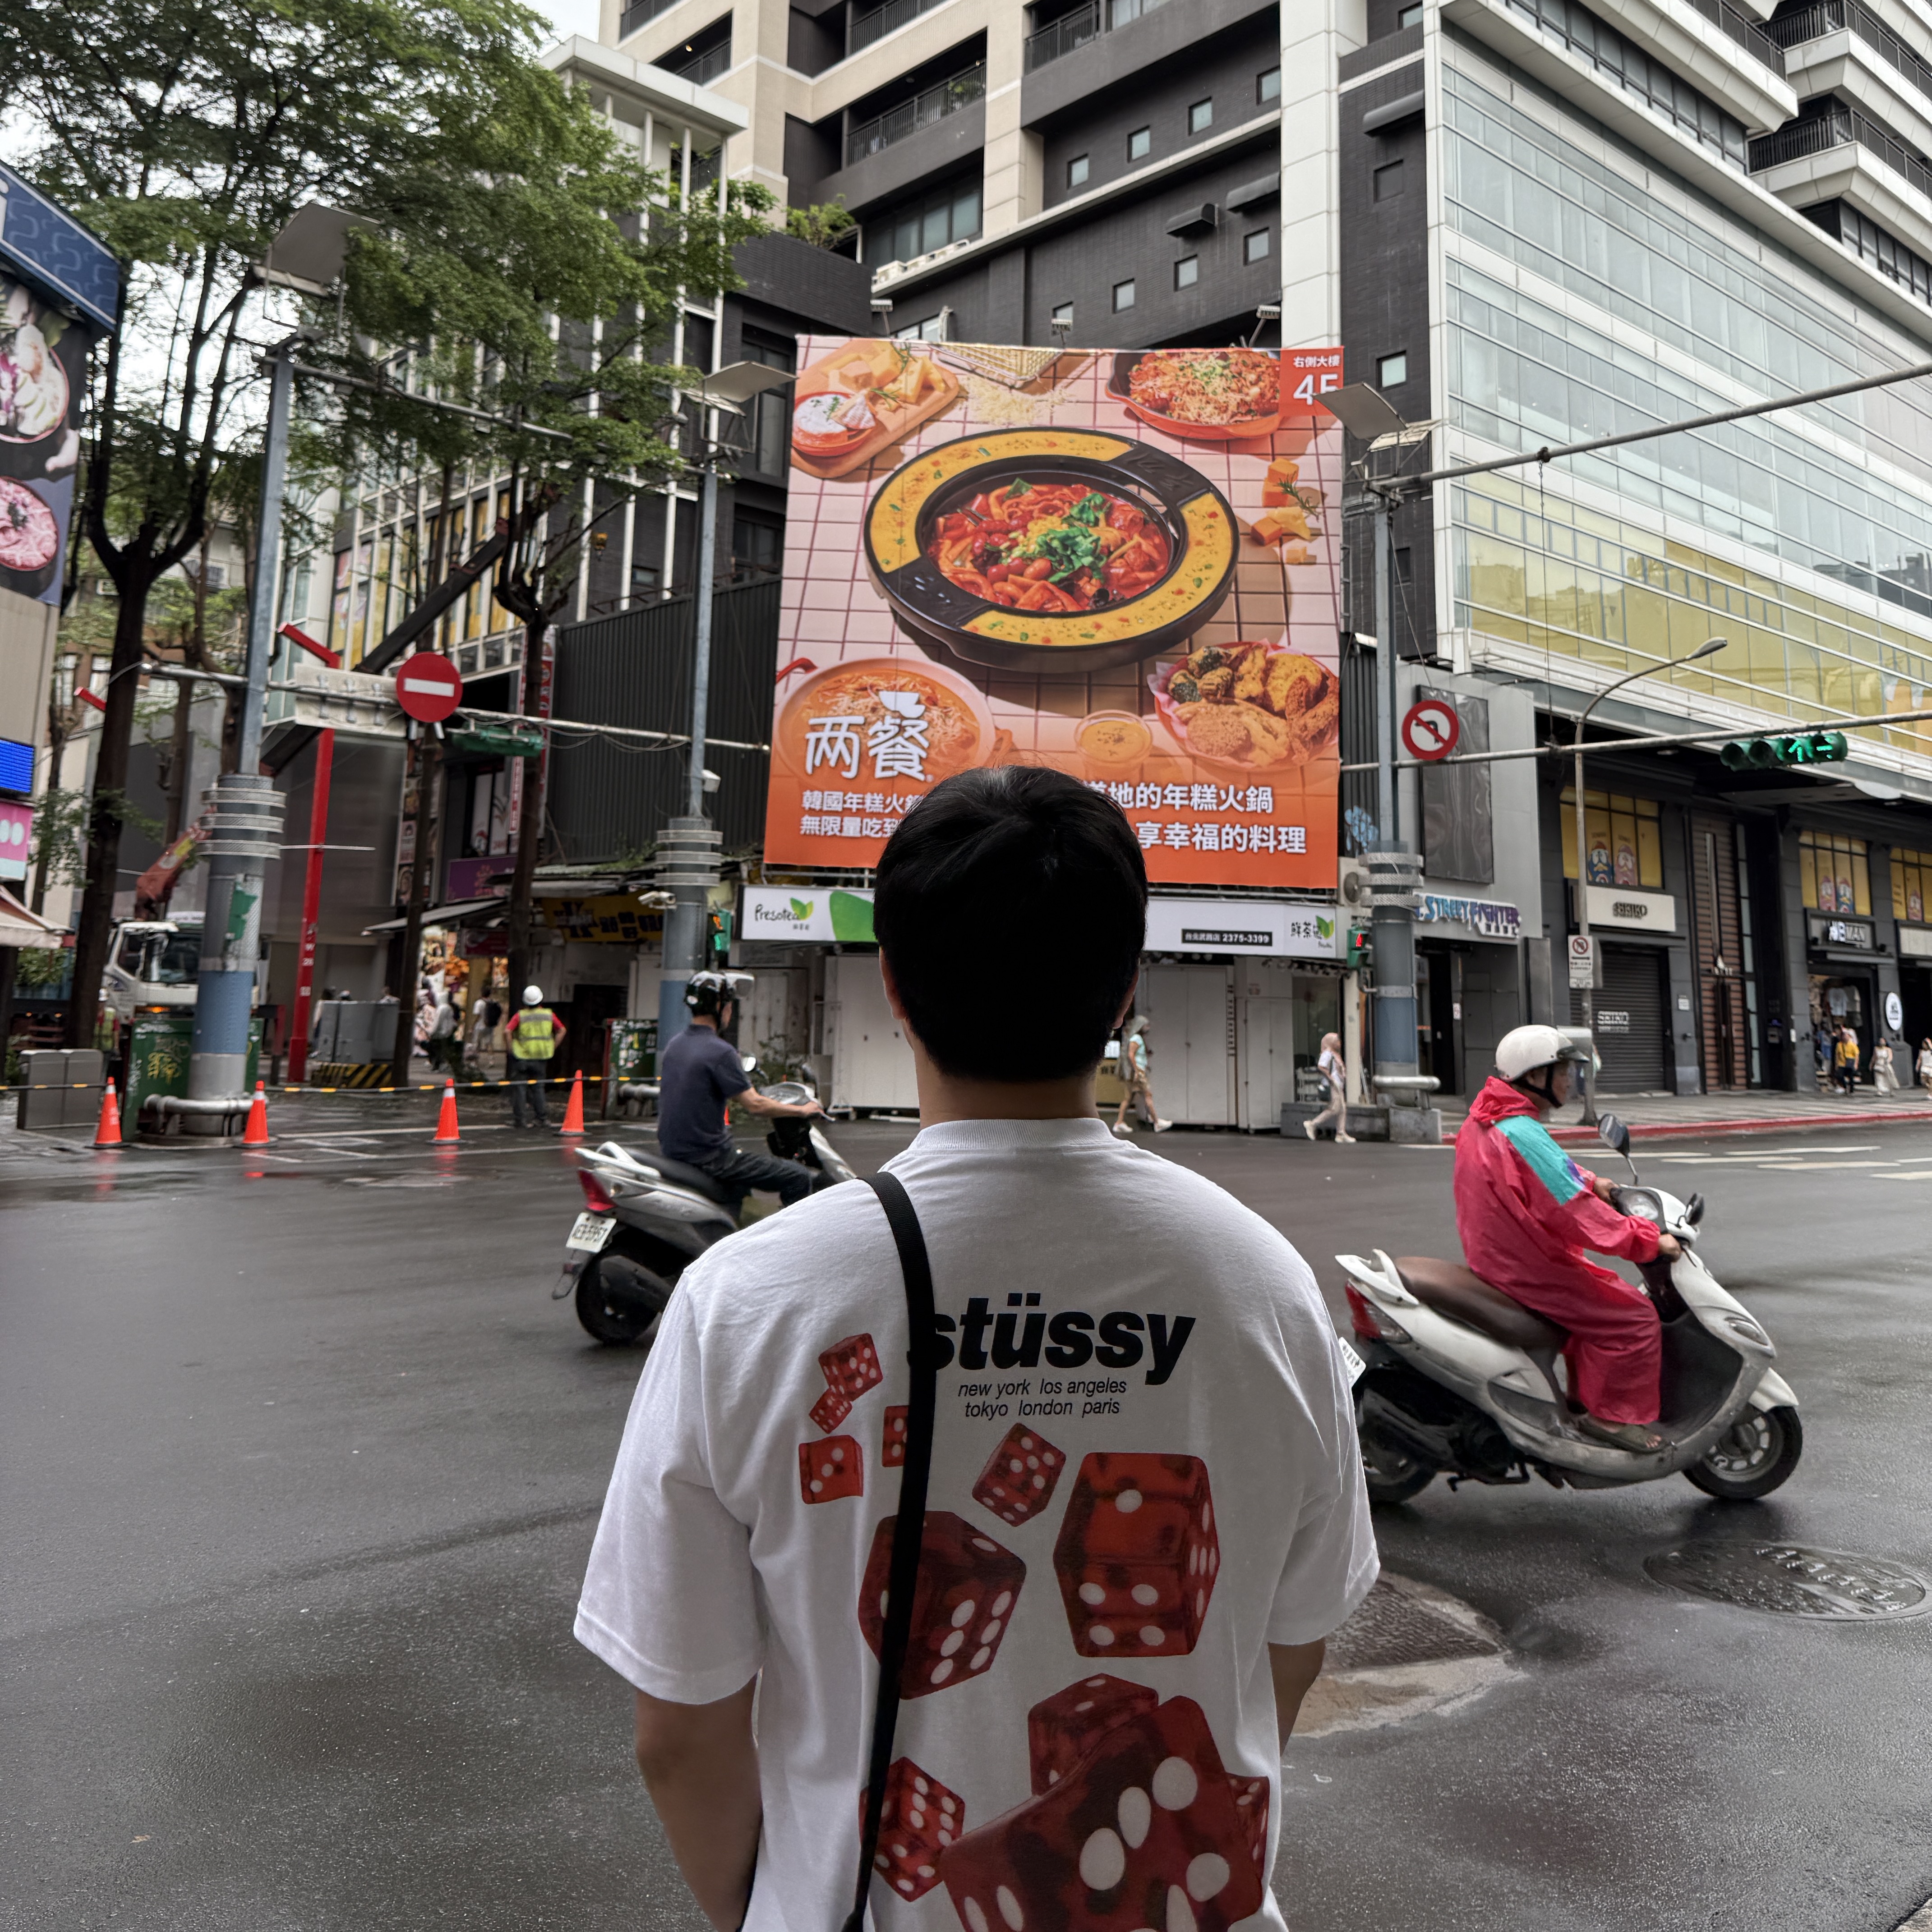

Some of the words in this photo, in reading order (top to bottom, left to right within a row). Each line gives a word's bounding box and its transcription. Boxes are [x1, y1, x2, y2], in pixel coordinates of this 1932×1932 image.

[1293, 355, 1340, 368] 右側大樓
[805, 715, 929, 781] 两餐
[1135, 821, 1307, 854] 享幸福的料理
[755, 904, 801, 921] Presotea
[1613, 902, 1647, 920] SEIKO
[958, 1383, 992, 1397] new
[996, 1379, 1031, 1399] york
[1040, 1379, 1062, 1394] los
[1068, 1377, 1127, 1397] angeles
[965, 1400, 1009, 1421] tokyo
[1018, 1399, 1073, 1416] london
[1083, 1399, 1120, 1418] paris
